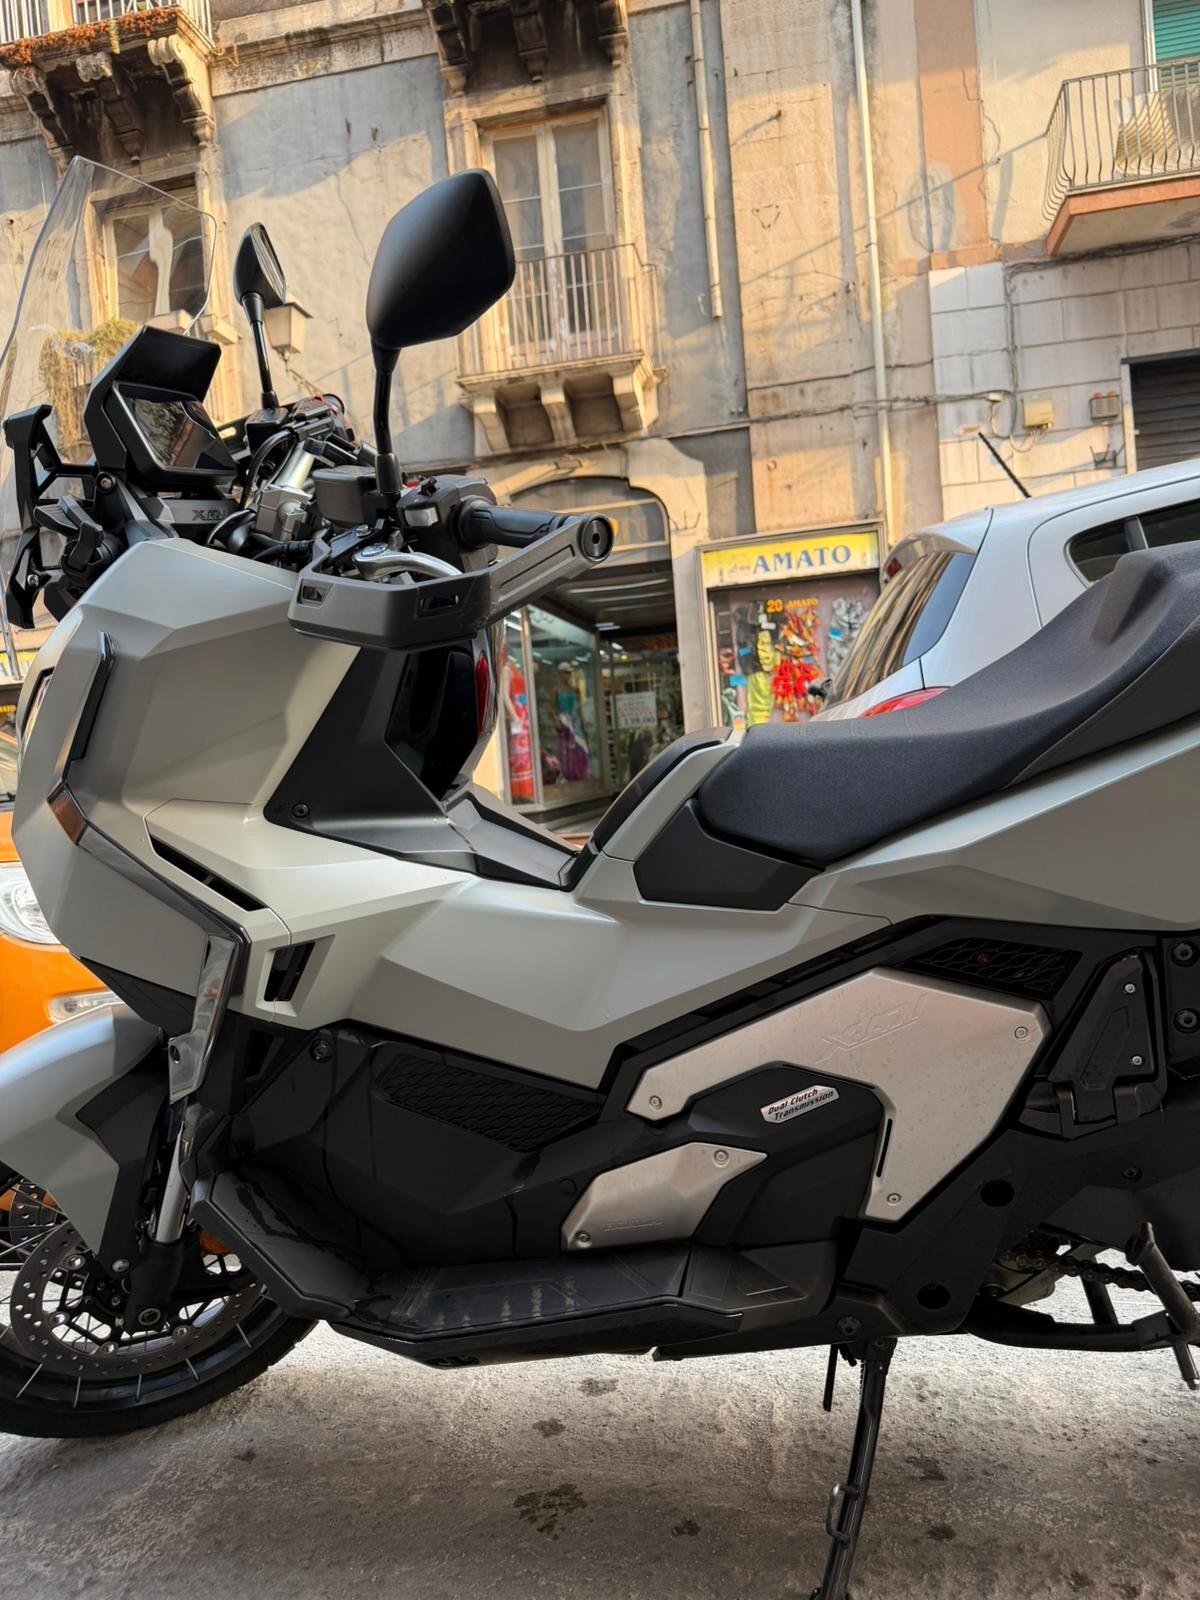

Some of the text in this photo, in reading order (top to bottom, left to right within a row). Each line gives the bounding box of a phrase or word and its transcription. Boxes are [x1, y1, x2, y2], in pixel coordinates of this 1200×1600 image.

[753, 544, 851, 575] AMATO
[768, 1088, 819, 1115] Dual Clutch
[774, 1090, 834, 1121] Transmission
